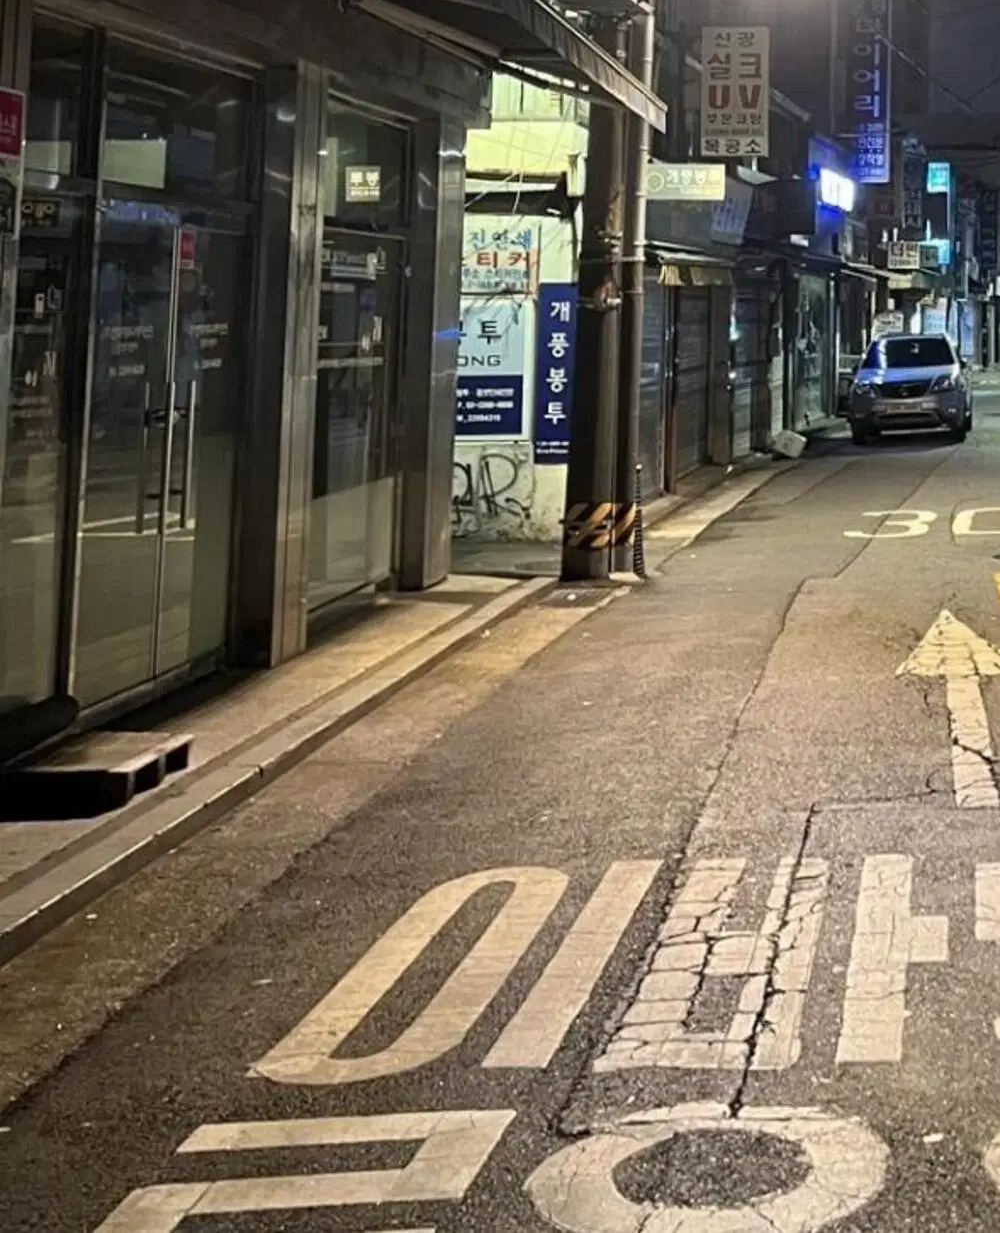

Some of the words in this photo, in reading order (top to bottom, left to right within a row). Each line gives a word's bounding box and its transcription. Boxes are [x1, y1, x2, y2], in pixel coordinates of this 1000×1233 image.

[707, 52, 762, 80] 실크
[708, 84, 762, 109] UV
[544, 301, 571, 425] 개풍봉투
